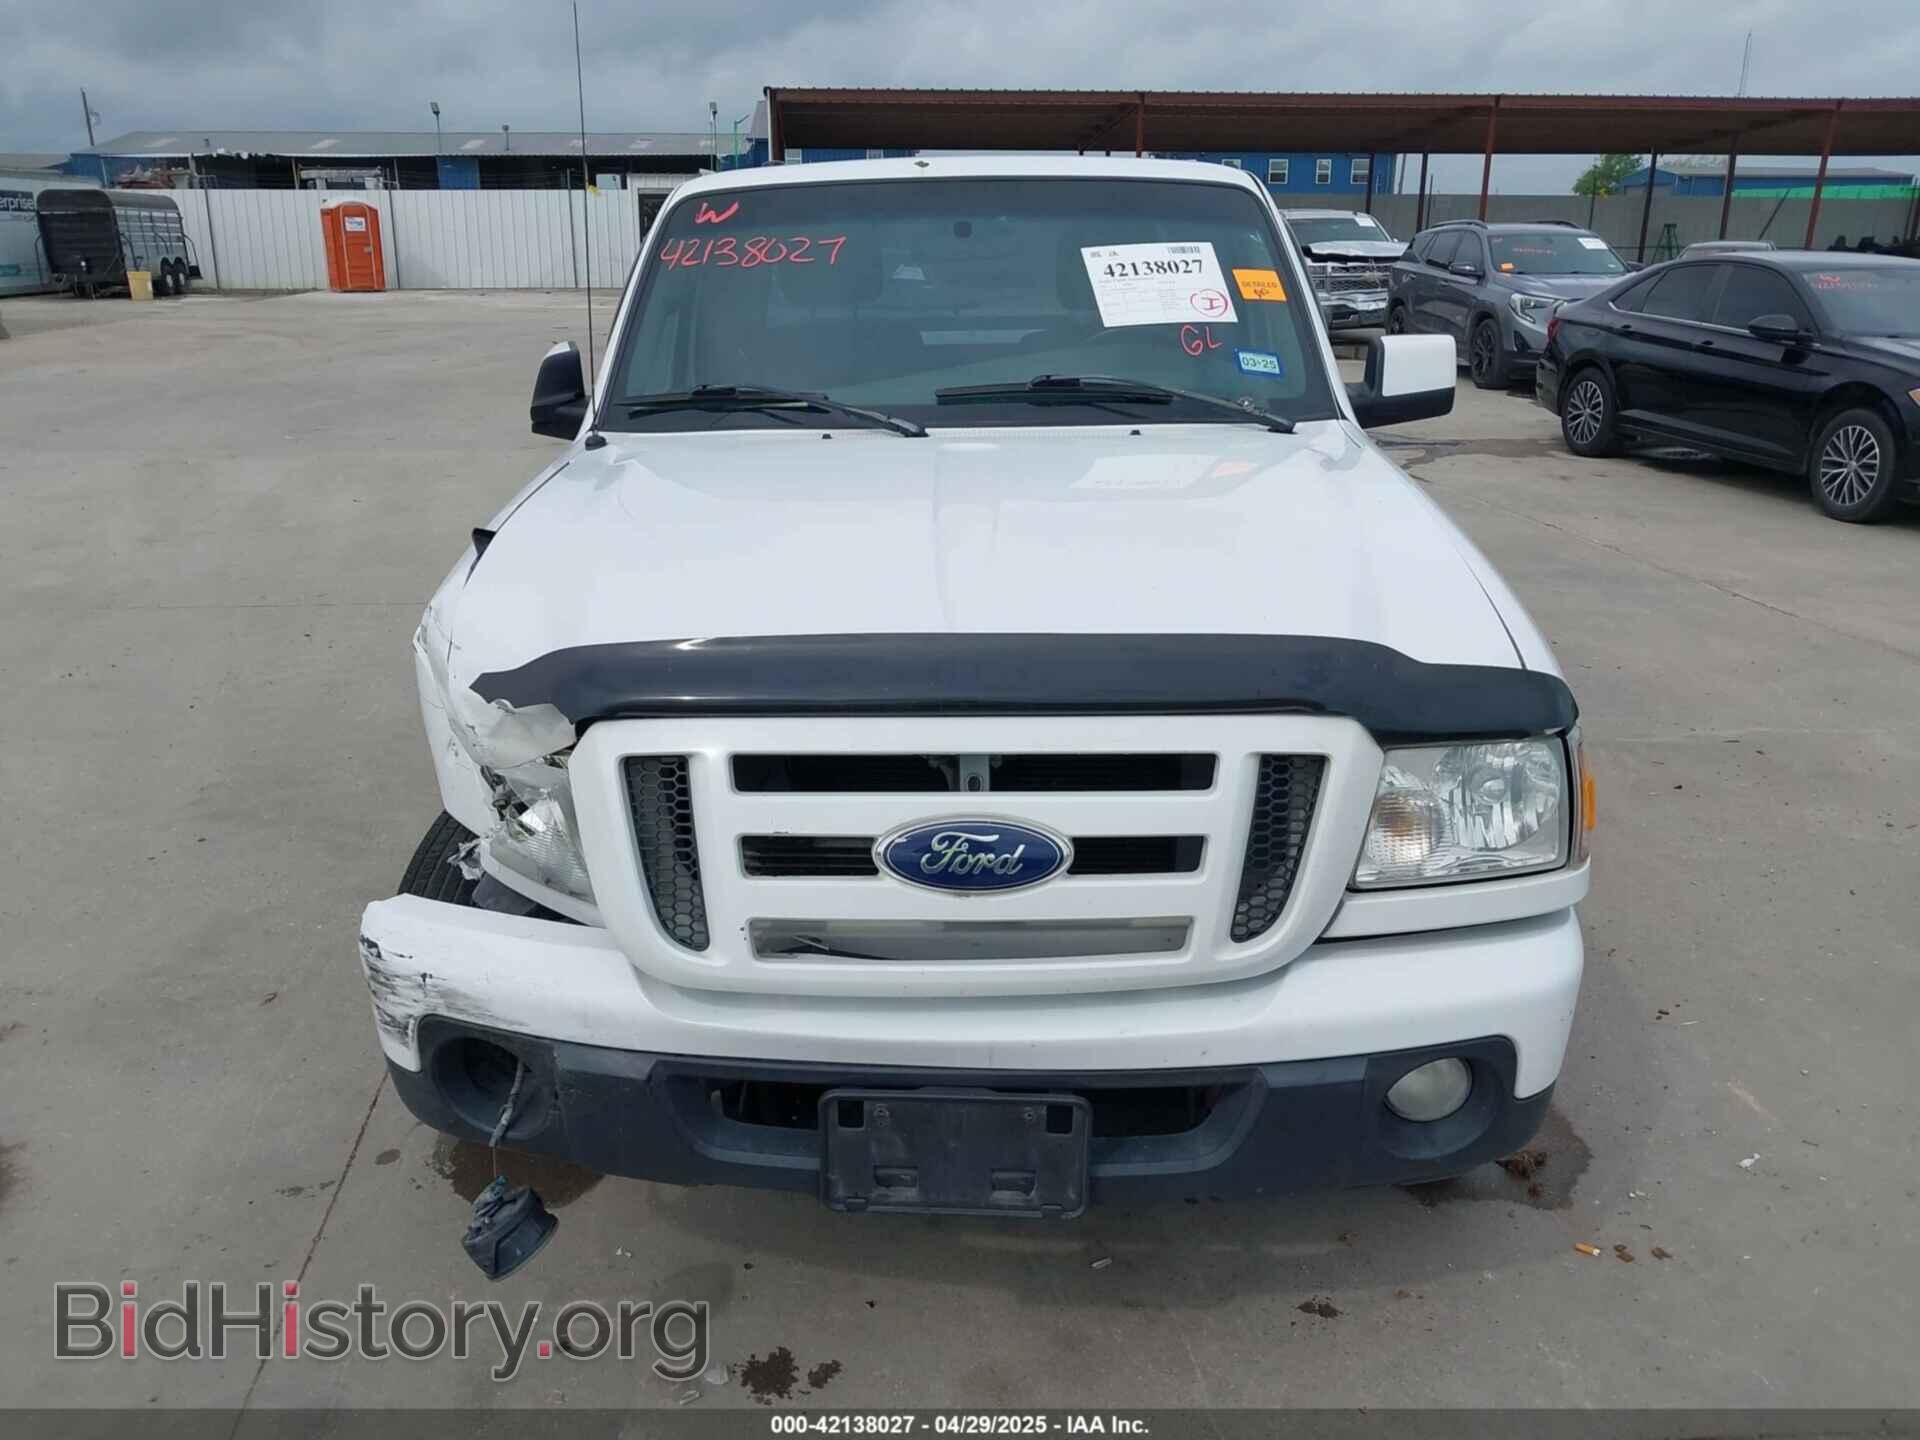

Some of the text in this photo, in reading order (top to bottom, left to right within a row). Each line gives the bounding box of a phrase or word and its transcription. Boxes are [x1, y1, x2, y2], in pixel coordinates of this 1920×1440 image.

[660, 235, 847, 270] 42138027
[1103, 258, 1203, 277] 42138027
[920, 831, 1026, 874] Ford
